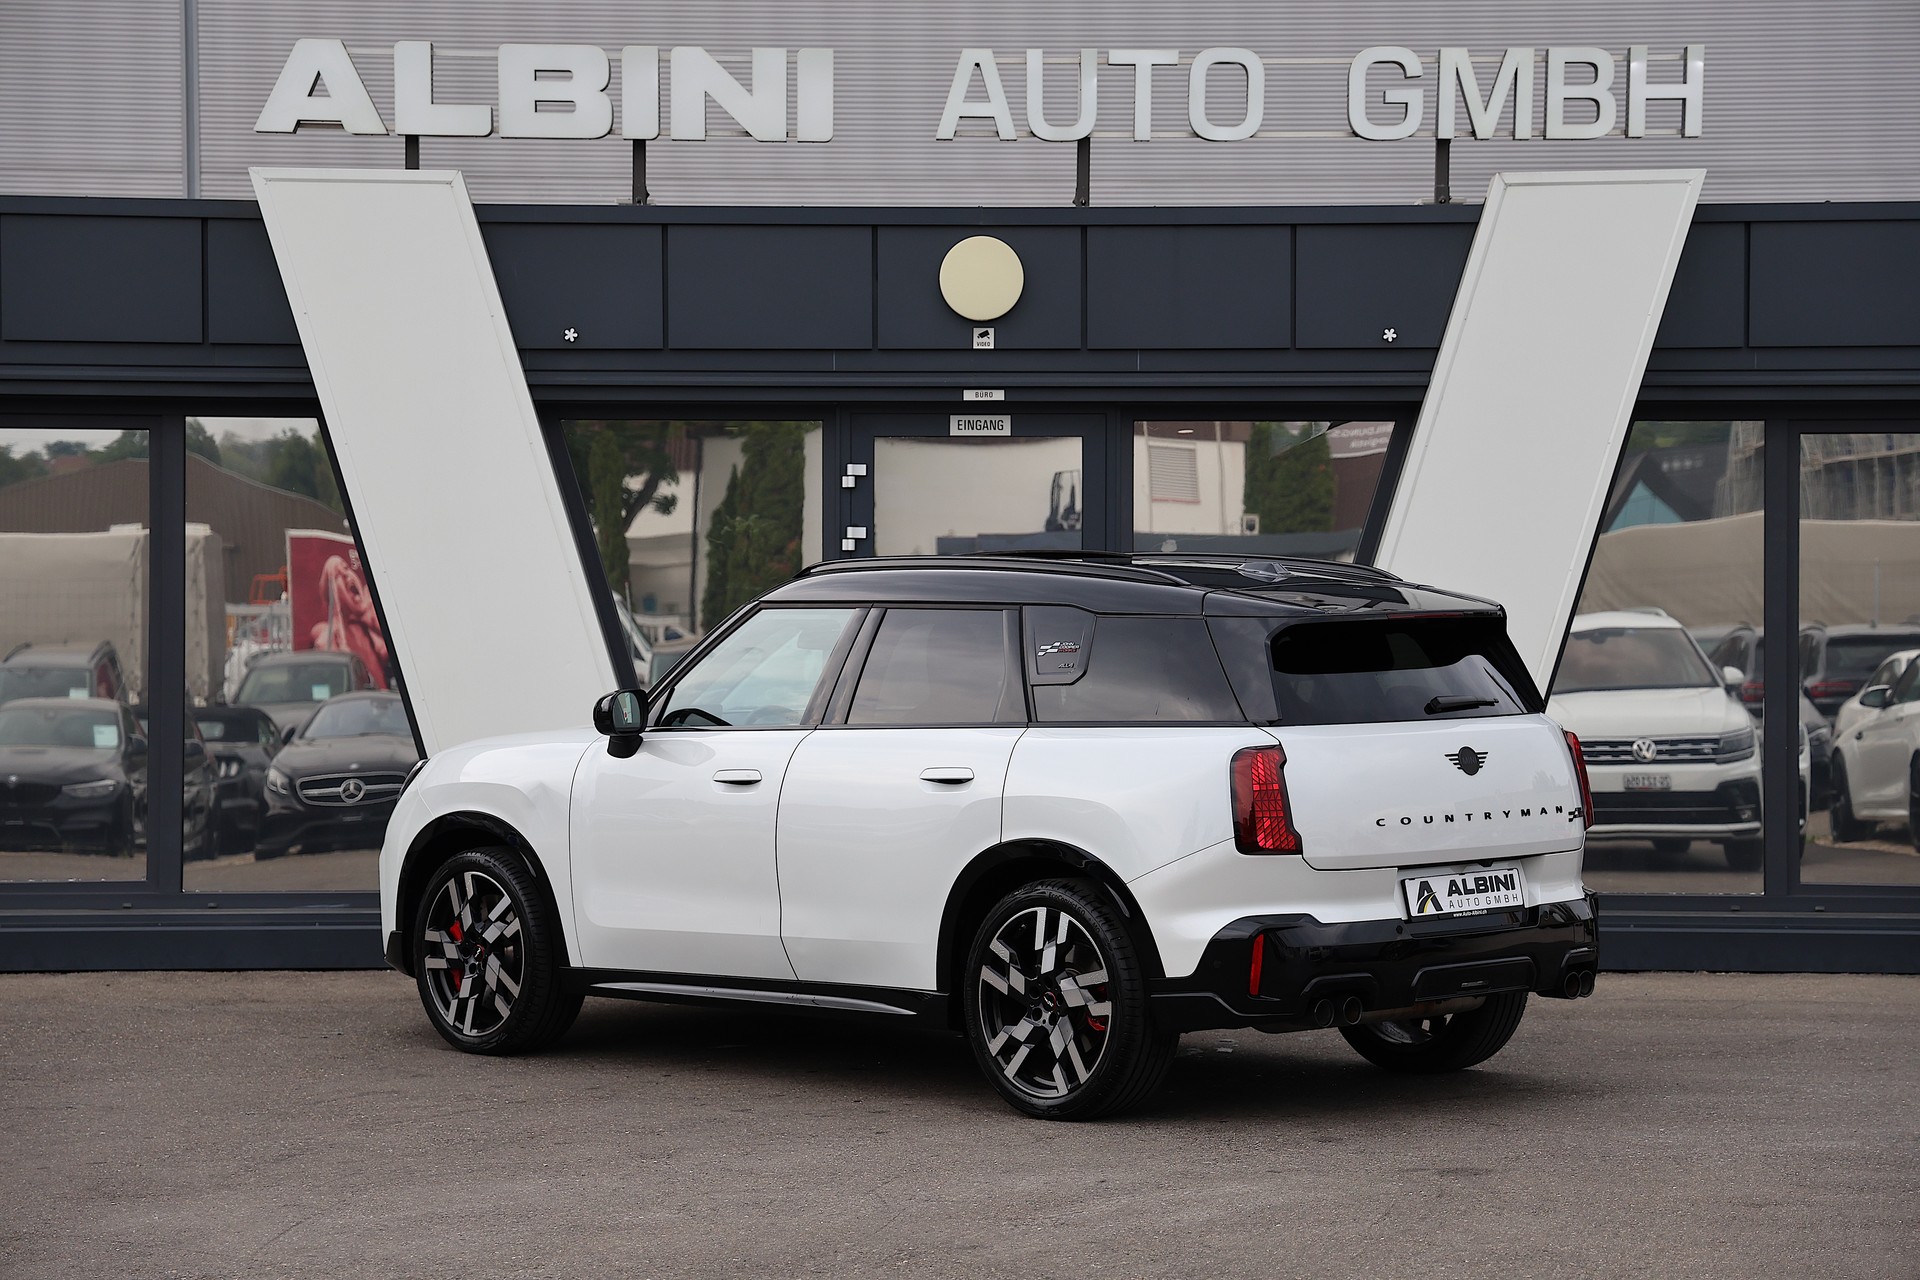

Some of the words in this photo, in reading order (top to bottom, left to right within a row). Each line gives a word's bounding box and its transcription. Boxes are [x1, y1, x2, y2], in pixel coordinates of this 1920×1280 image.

[254, 38, 834, 142] ALBINI
[936, 47, 1266, 142] AUTO
[1347, 45, 1705, 141] GMBH
[975, 390, 993, 398] BÜRO
[957, 419, 1004, 430] EINGANG
[1375, 805, 1563, 827] COUNTRYMAN
[1447, 873, 1516, 897] ALBINI
[1449, 897, 1480, 909] AUTO
[1486, 893, 1519, 906] GMBH
